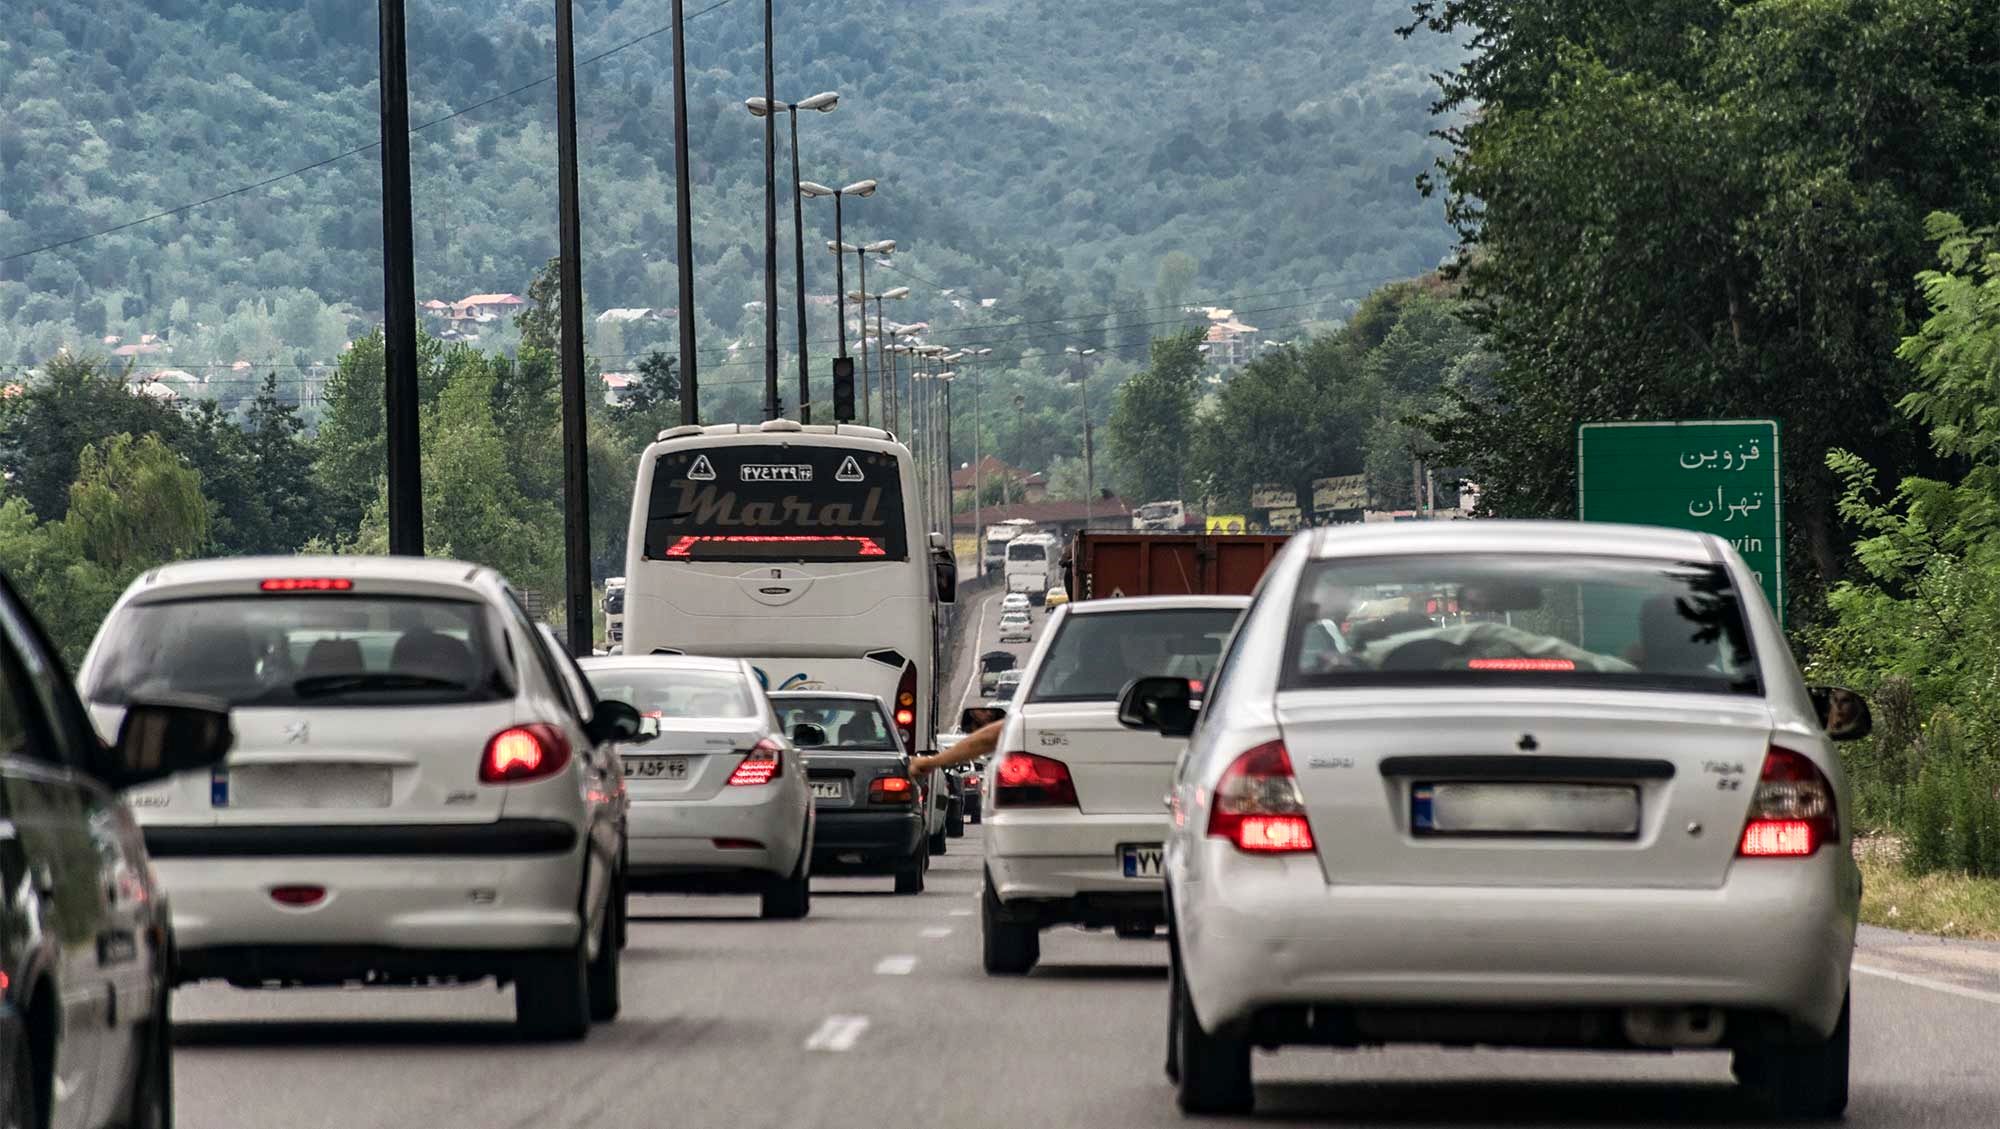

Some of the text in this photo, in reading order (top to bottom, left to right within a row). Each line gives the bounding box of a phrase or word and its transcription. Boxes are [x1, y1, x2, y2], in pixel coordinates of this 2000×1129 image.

[1680, 438, 1760, 471] قزوین
[666, 479, 886, 527] Maral
[1688, 485, 1763, 521] تهران
